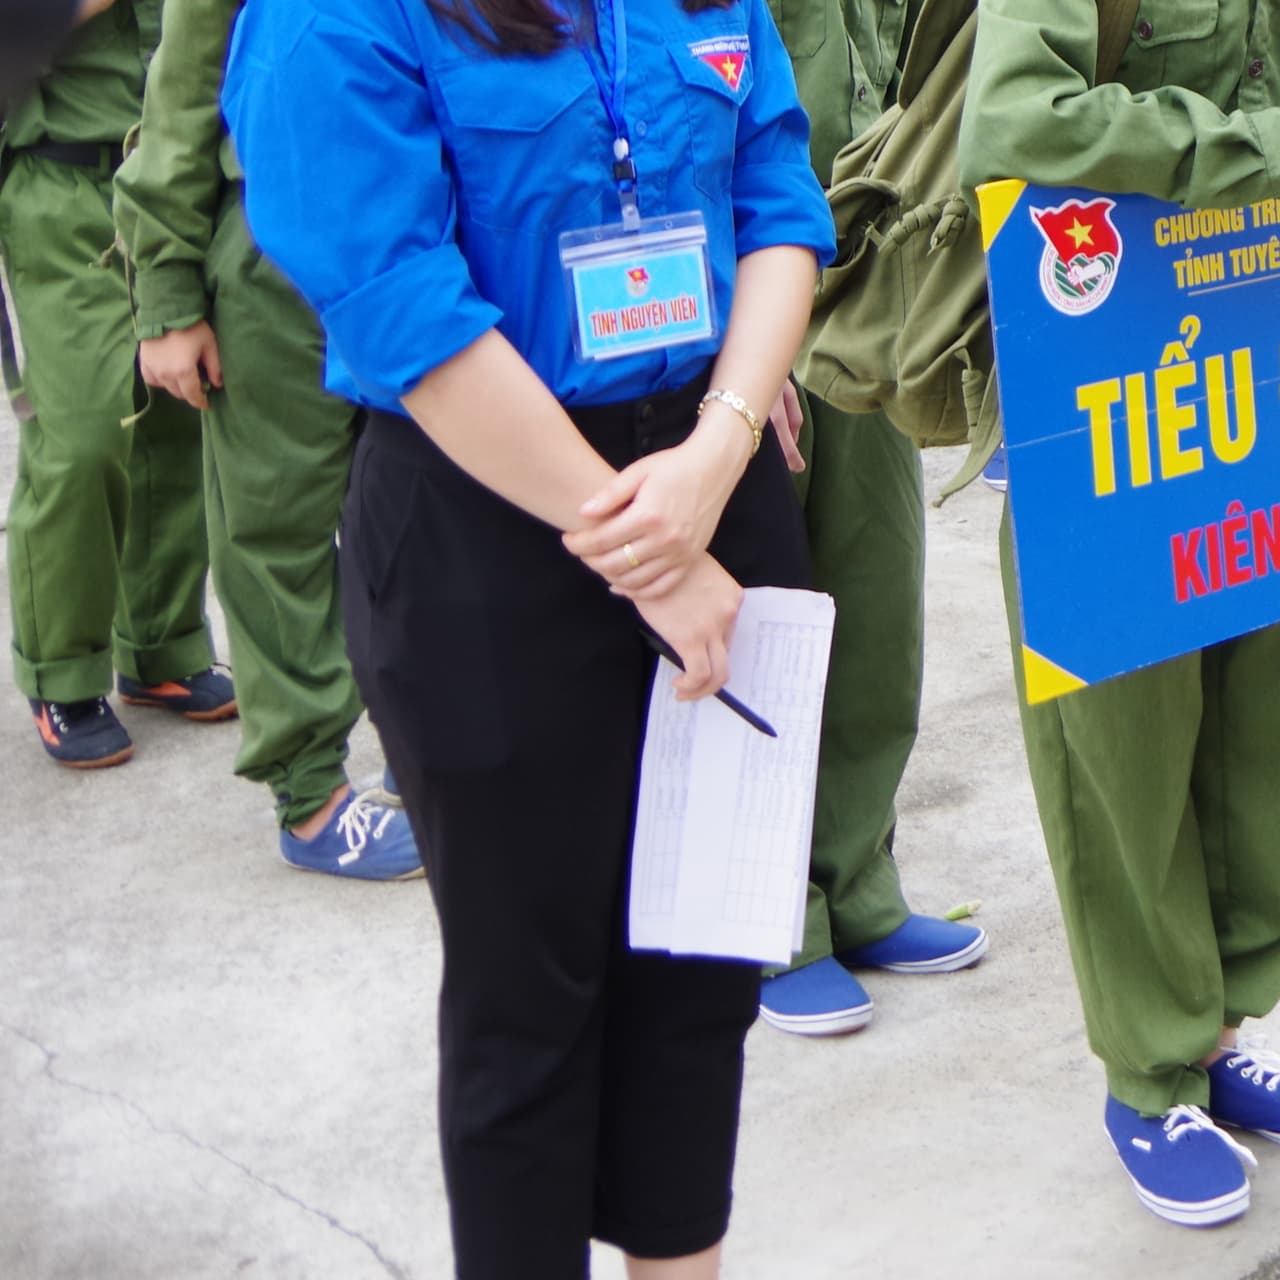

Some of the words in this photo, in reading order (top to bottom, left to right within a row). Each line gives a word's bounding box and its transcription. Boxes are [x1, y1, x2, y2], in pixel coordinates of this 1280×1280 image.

[1154, 208, 1245, 246] CHƯƠNG
[1173, 247, 1225, 289] TỈNH
[621, 297, 668, 331] NGUYỆN
[670, 293, 698, 322] VIÊN
[1076, 314, 1257, 497] TIỂU
